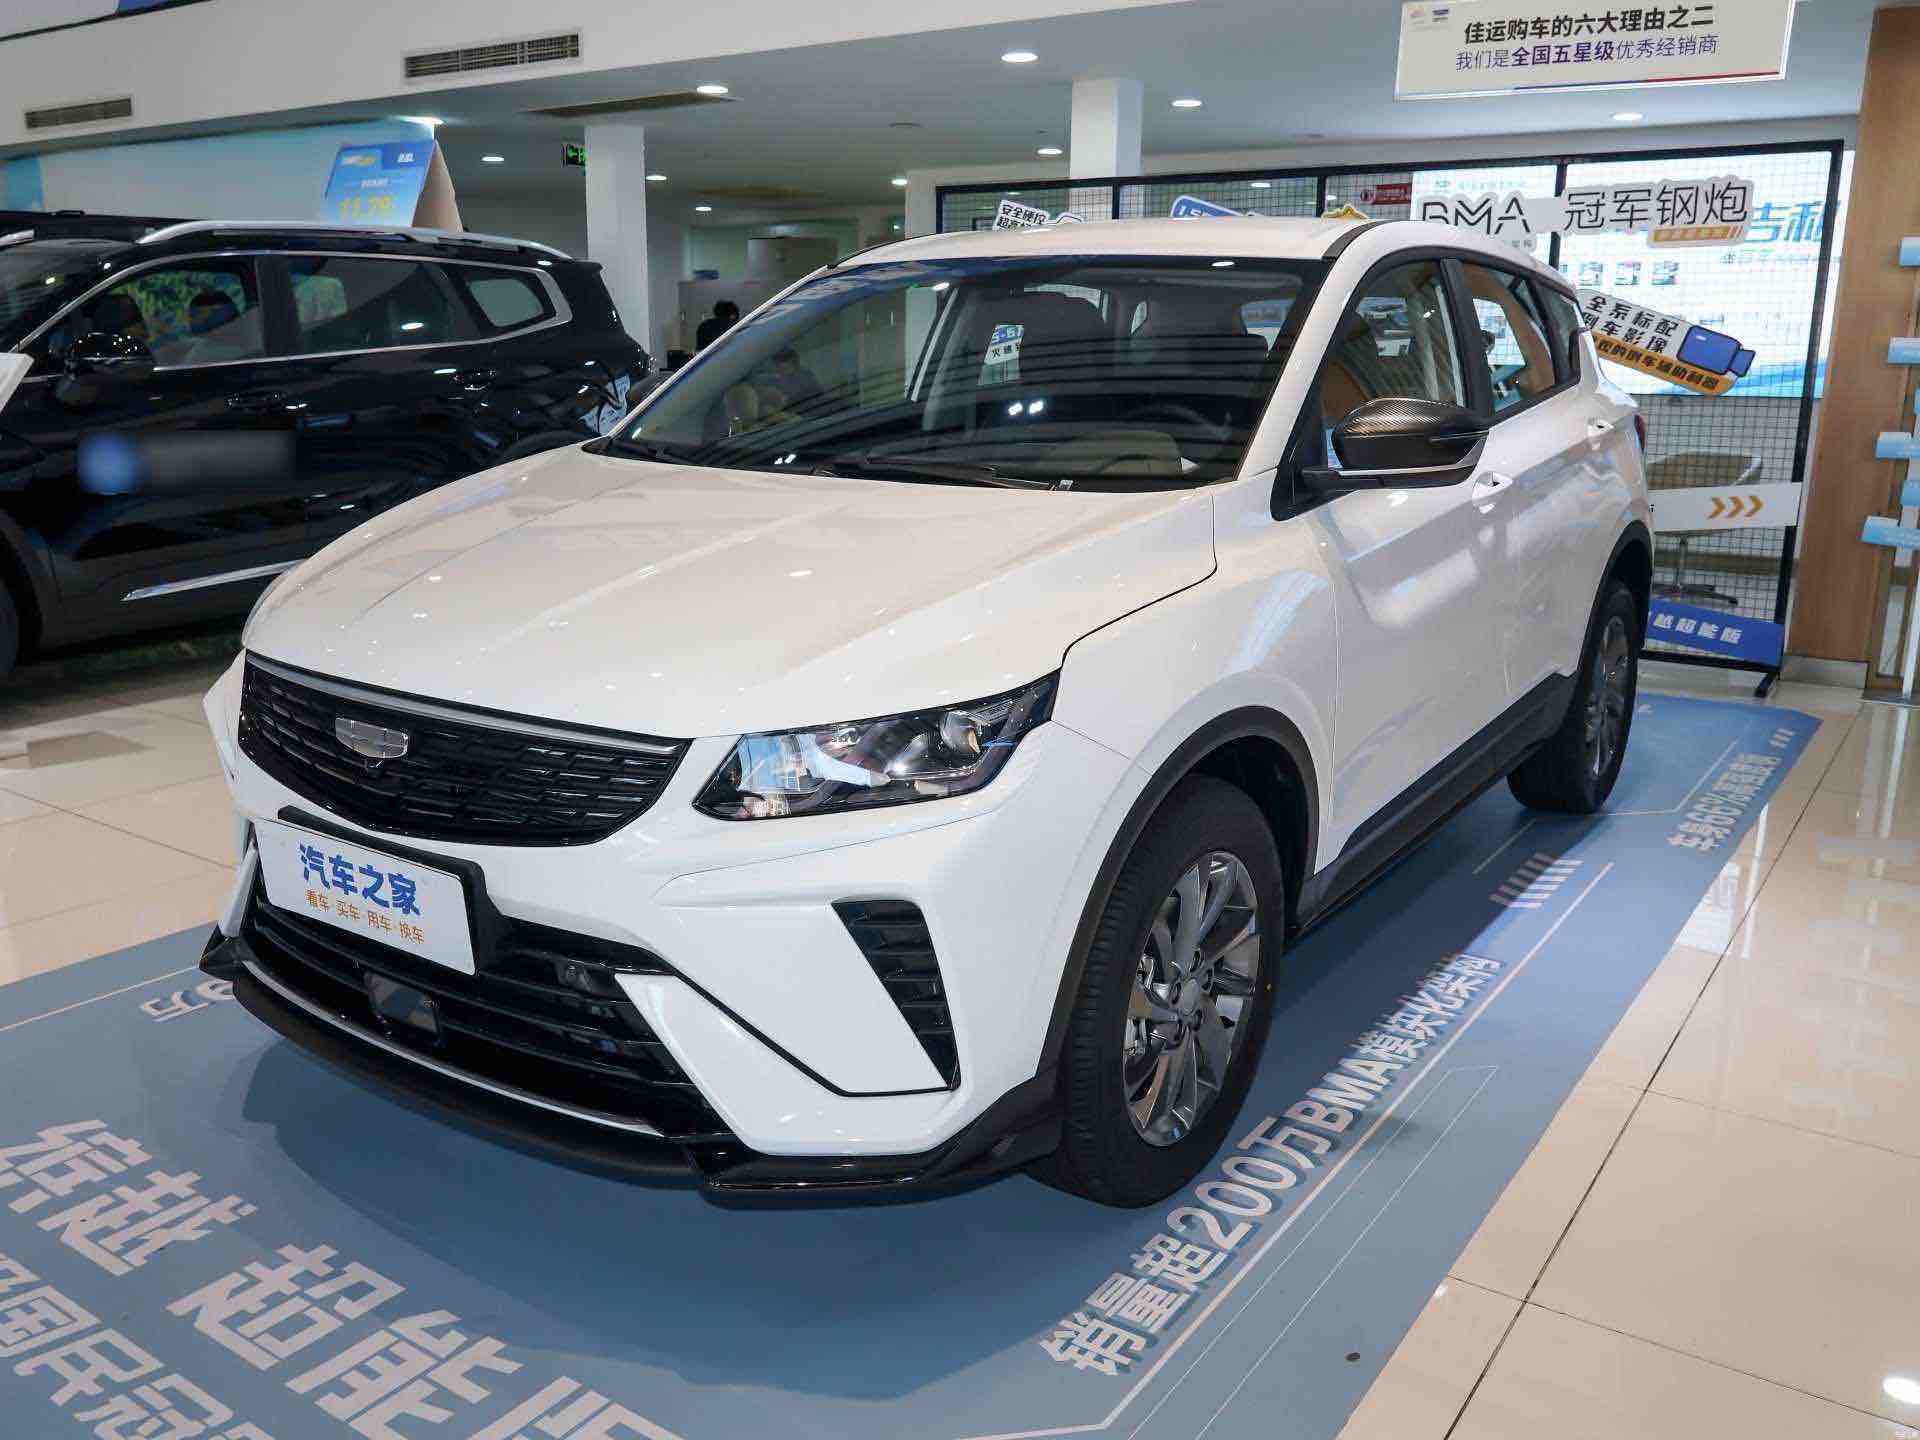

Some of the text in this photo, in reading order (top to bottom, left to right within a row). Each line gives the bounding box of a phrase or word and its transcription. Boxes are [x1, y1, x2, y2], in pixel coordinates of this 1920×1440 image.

[1464, 5, 1714, 45] 佳运购车的六大理由之二
[1455, 33, 1719, 72] 我们是全国五星级优秀经销商
[1564, 181, 1748, 231] 冠军钢炮
[1586, 296, 1679, 336] 全系标配
[1649, 612, 1743, 645] 越超能版
[298, 843, 420, 916] 汽车之家
[306, 889, 425, 945] 看车 买车 用车 换车
[1039, 953, 1505, 1377] 销量超200万BMA模块化架构
[0, 1253, 276, 1440] 国民冠
